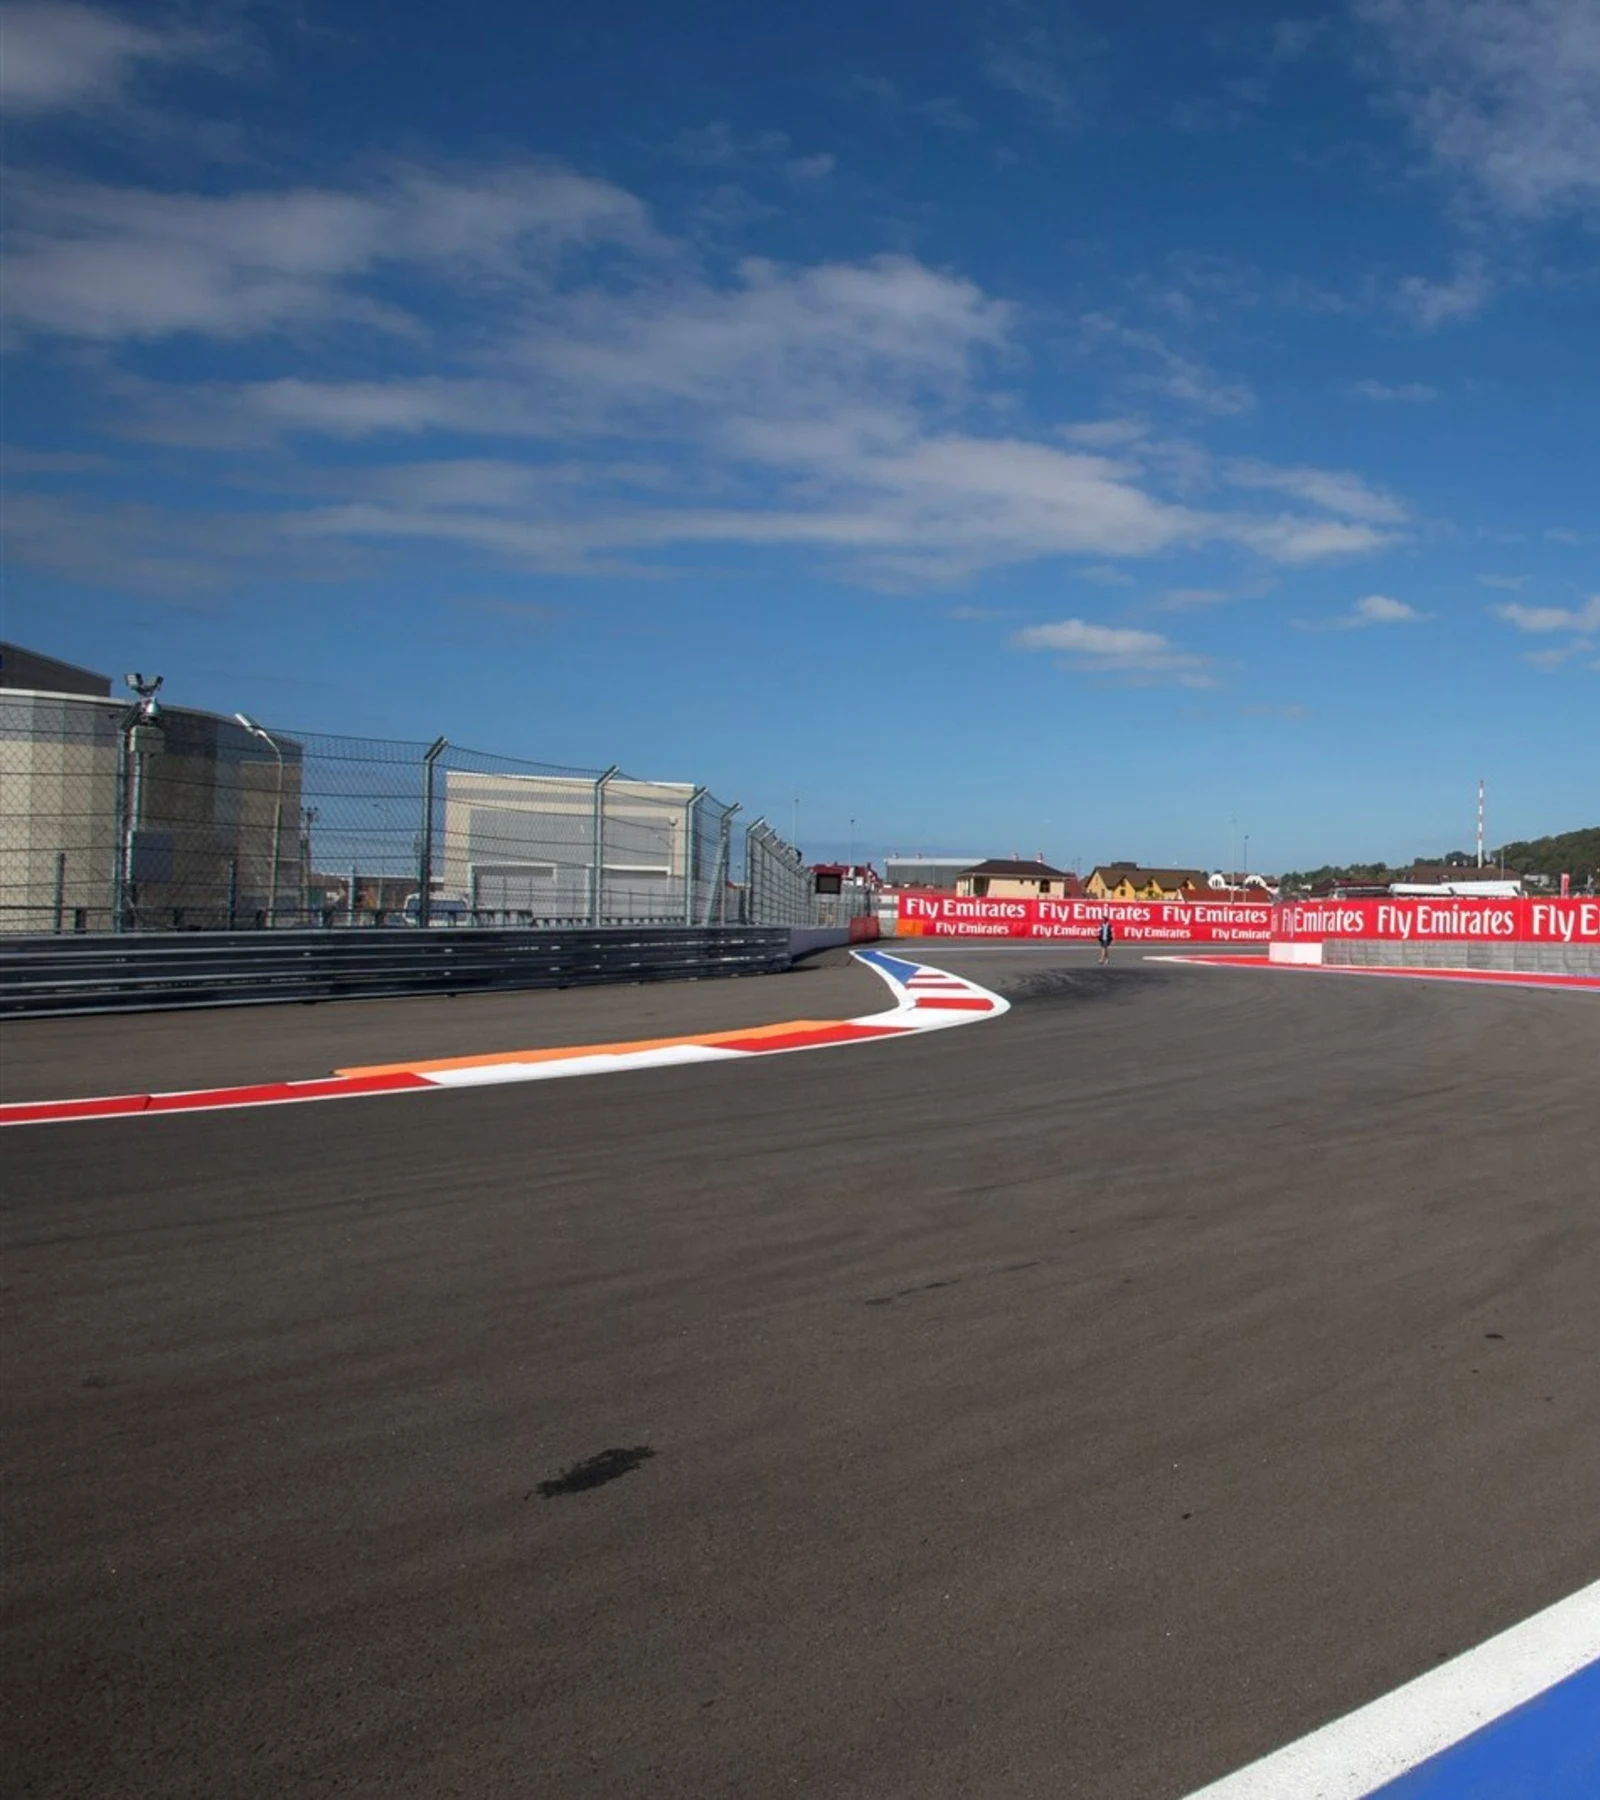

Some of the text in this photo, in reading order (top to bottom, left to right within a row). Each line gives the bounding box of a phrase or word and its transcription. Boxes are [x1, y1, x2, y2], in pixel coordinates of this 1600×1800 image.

[906, 898, 1026, 918] Fly Emirates
[1039, 903, 1150, 922] Fly Emirates
[1163, 906, 1191, 925] Fly
[1195, 907, 1267, 923] Emirates
[936, 922, 1009, 935] Fly Emirates
[1294, 905, 1364, 933] Emirates
[1378, 905, 1514, 939] Fly Emirates
[1532, 905, 1574, 941] Fly
[1033, 924, 1052, 937] Fly
[1124, 926, 1191, 938] Fly Emirates
